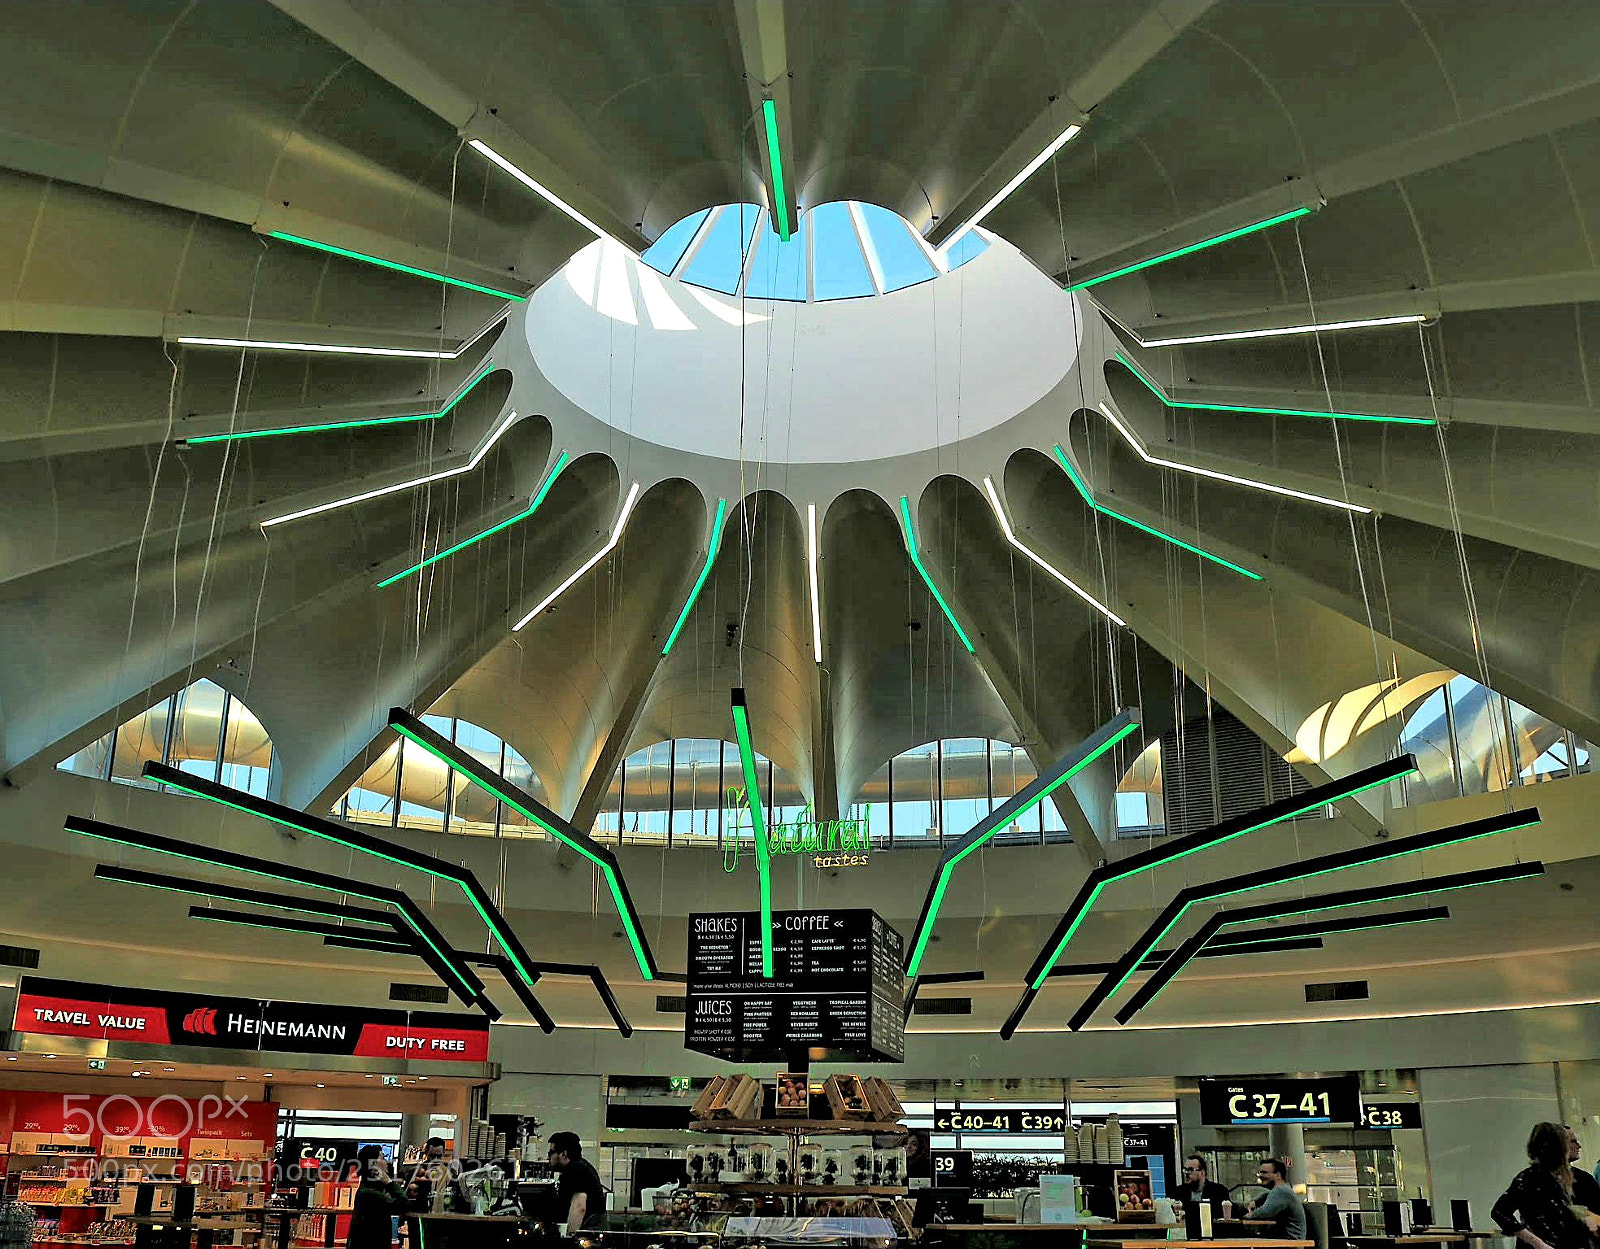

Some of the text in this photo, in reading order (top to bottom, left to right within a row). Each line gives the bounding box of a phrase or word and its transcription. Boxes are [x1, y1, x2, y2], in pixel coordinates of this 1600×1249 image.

[813, 853, 869, 869] tastes
[694, 917, 738, 933] SHAKES
[785, 915, 830, 931] COFFEE
[695, 1000, 732, 1015] JUICES
[33, 1008, 146, 1031] TRAVEL VALUE
[386, 1036, 465, 1051] DUTY FREE
